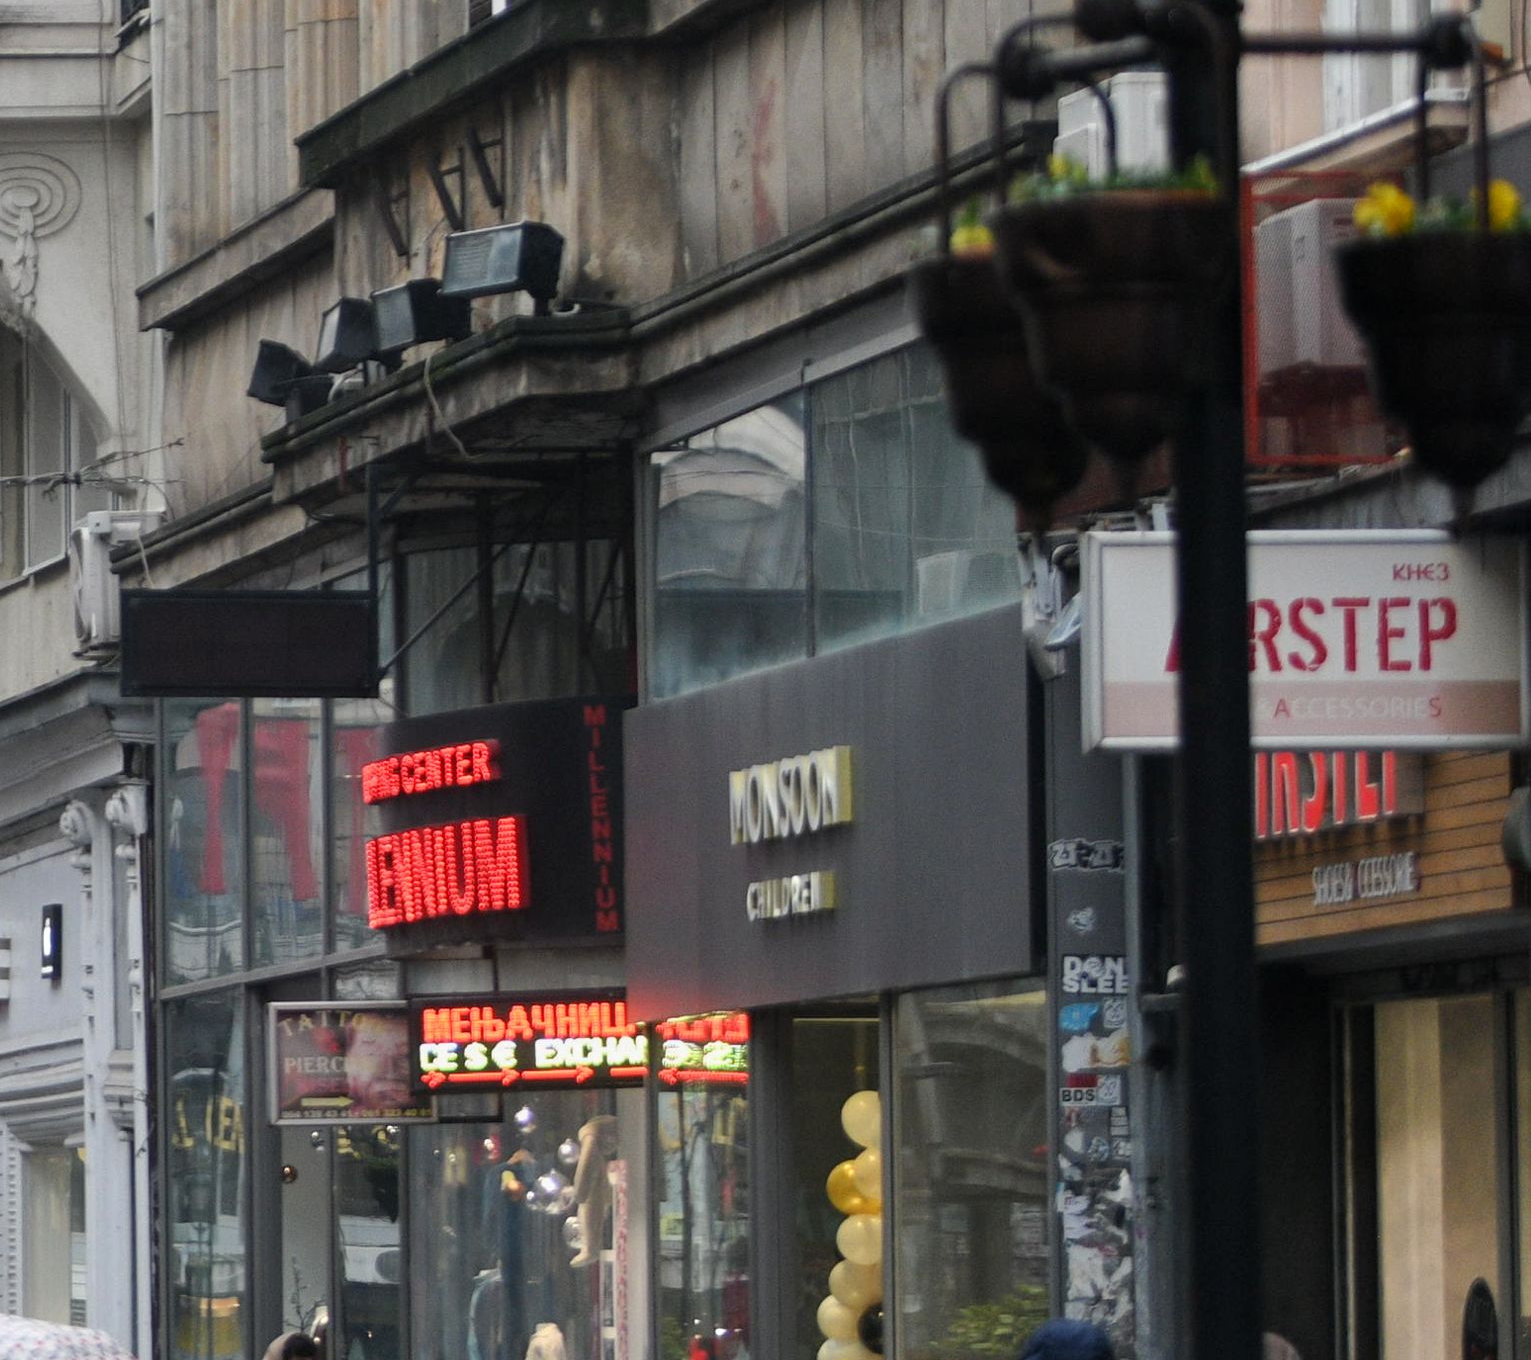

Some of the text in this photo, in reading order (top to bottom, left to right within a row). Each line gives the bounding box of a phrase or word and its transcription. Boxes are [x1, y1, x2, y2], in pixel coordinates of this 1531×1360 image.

[1164, 596, 1458, 673] RSTEP
[400, 741, 495, 794] CENTER
[729, 746, 846, 845] MONSOON
[746, 870, 830, 921] CHILDREN
[423, 1002, 636, 1043] МЕЊАЧНИЦ
[283, 1056, 350, 1074] PIERC
[1062, 1089, 1095, 1103] BDS
